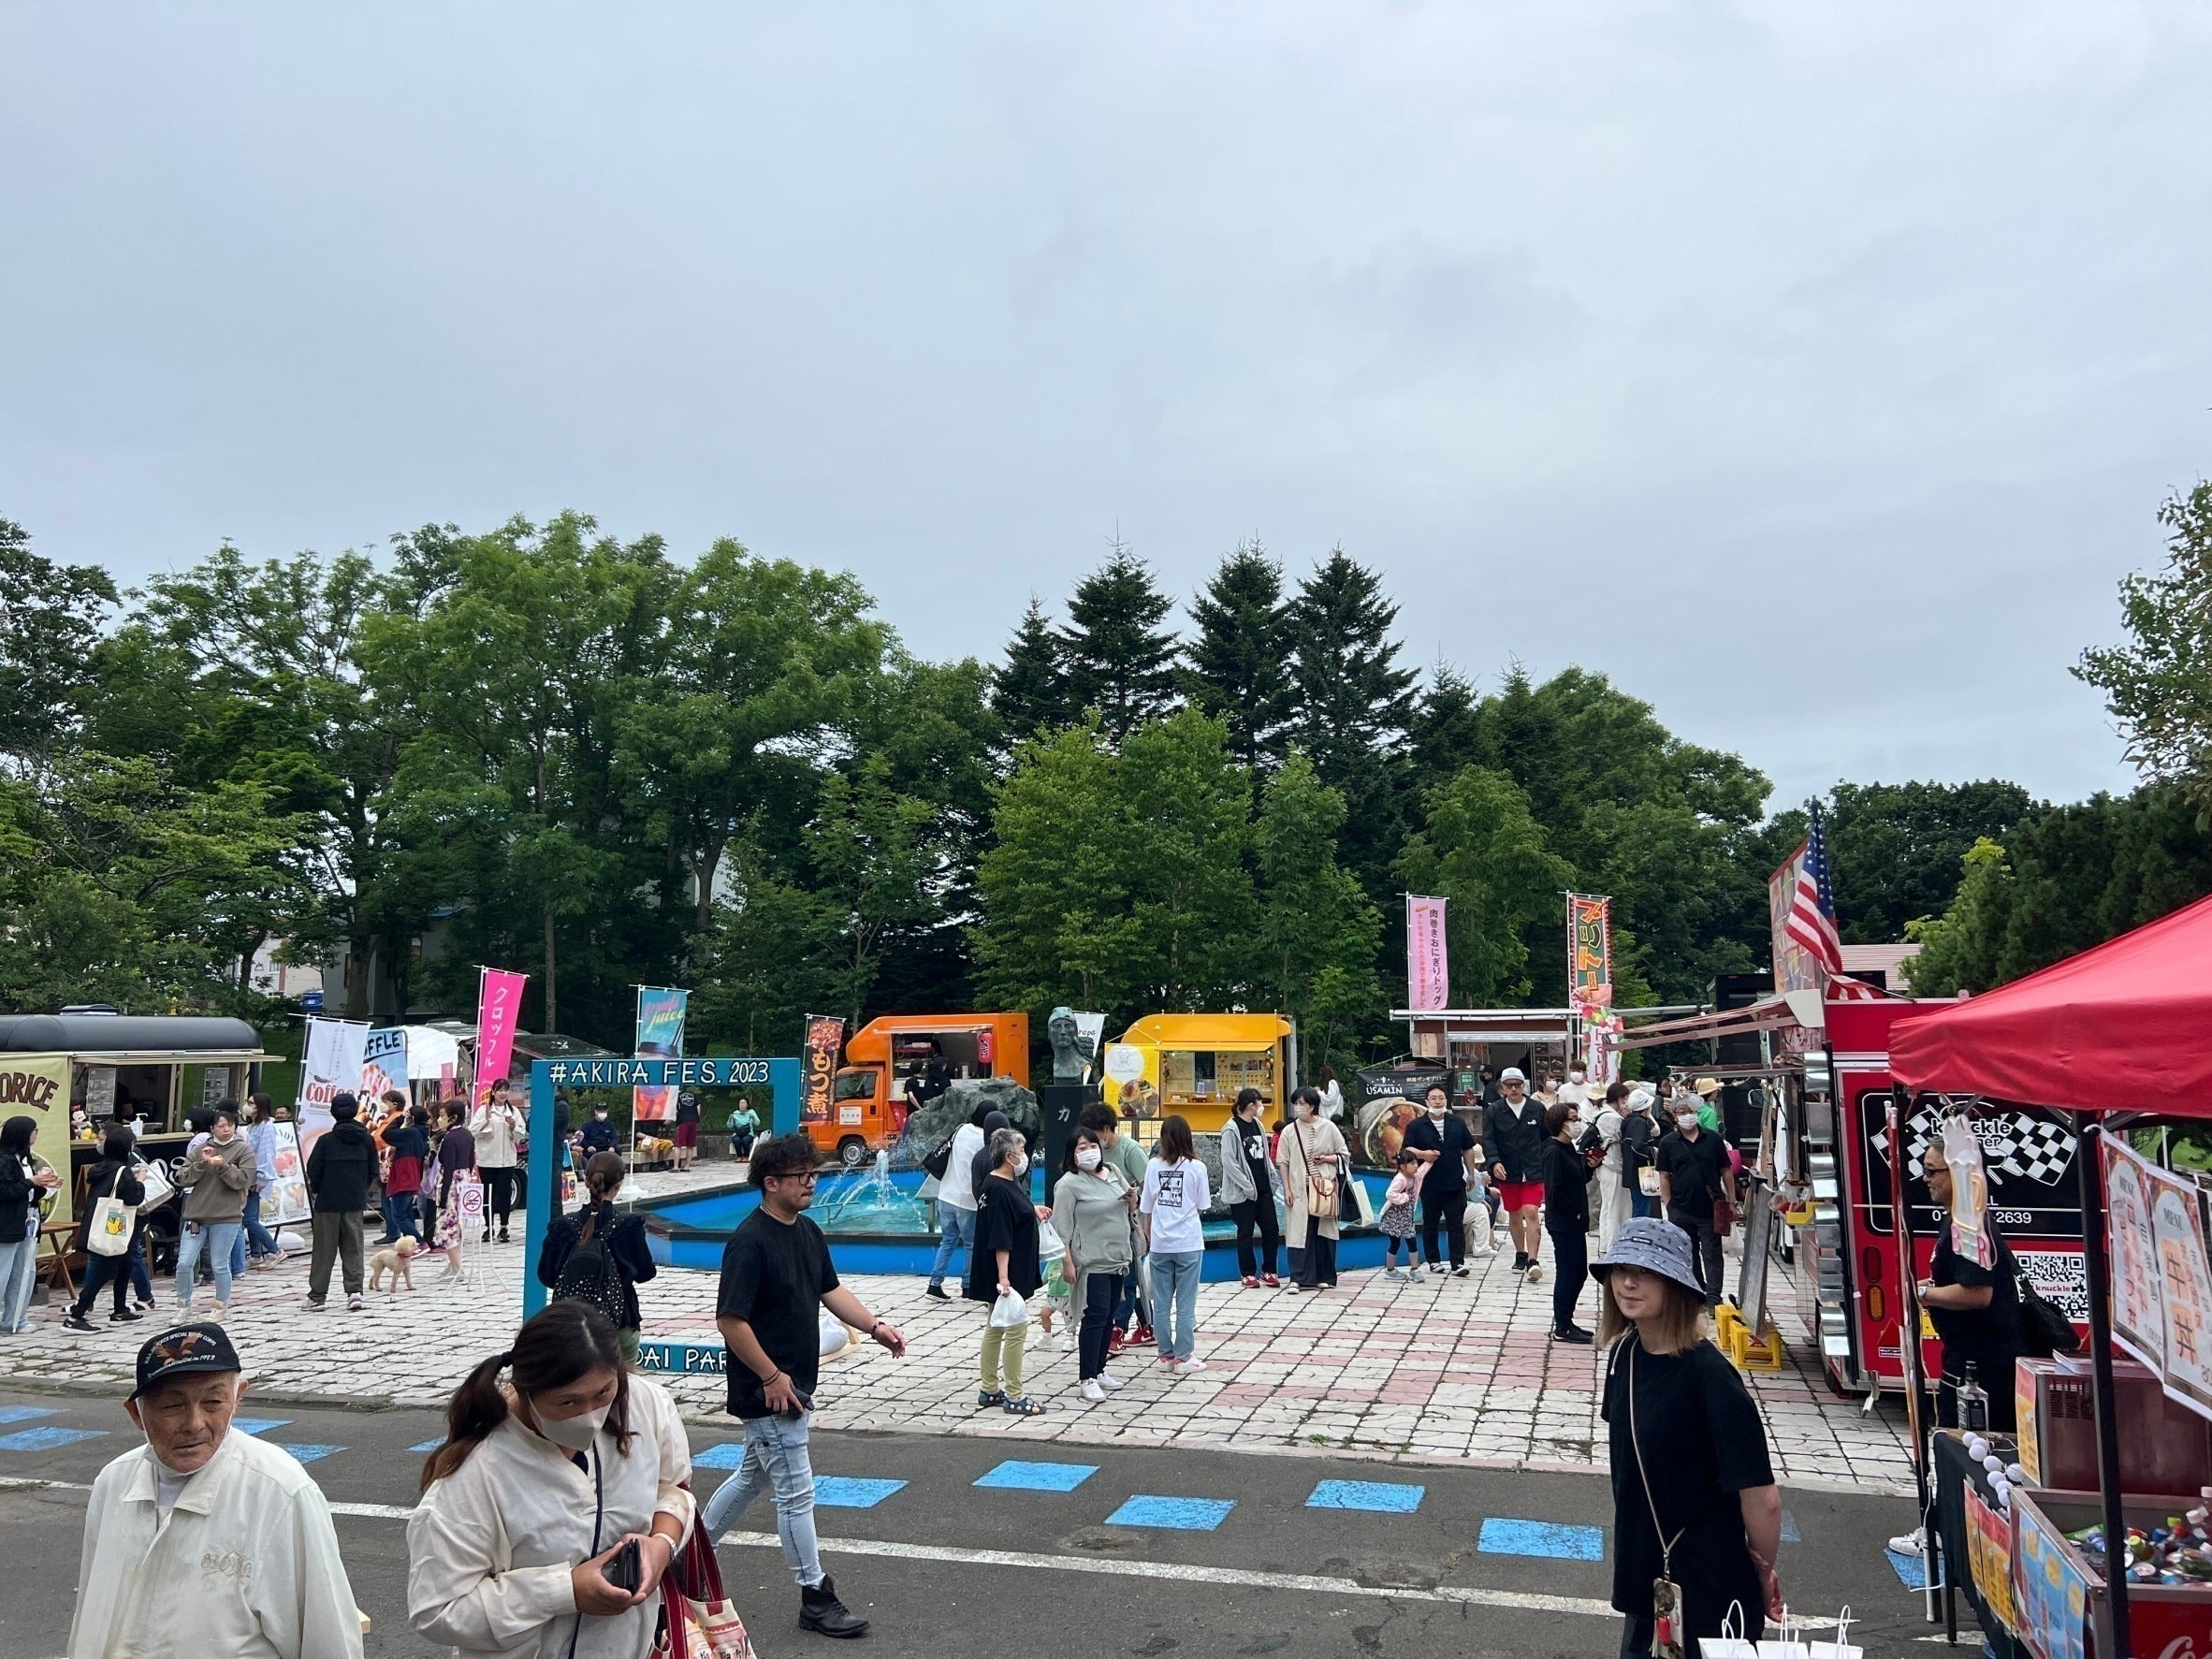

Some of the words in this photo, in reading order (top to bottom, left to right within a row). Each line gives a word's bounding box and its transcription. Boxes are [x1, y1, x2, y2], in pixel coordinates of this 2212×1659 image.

[1429, 909, 1442, 1005] 肉巻きおにぎりドッグ
[483, 986, 508, 1069] クロッフル
[365, 1031, 401, 1056] FFLE
[550, 1061, 648, 1084] #AKIRA
[662, 1061, 721, 1084] FES.
[729, 1061, 769, 1084] 2023
[807, 1047, 831, 1114] もつ煮
[1366, 1086, 1403, 1095] USAMIN
[1931, 1118, 2011, 1135] kckle
